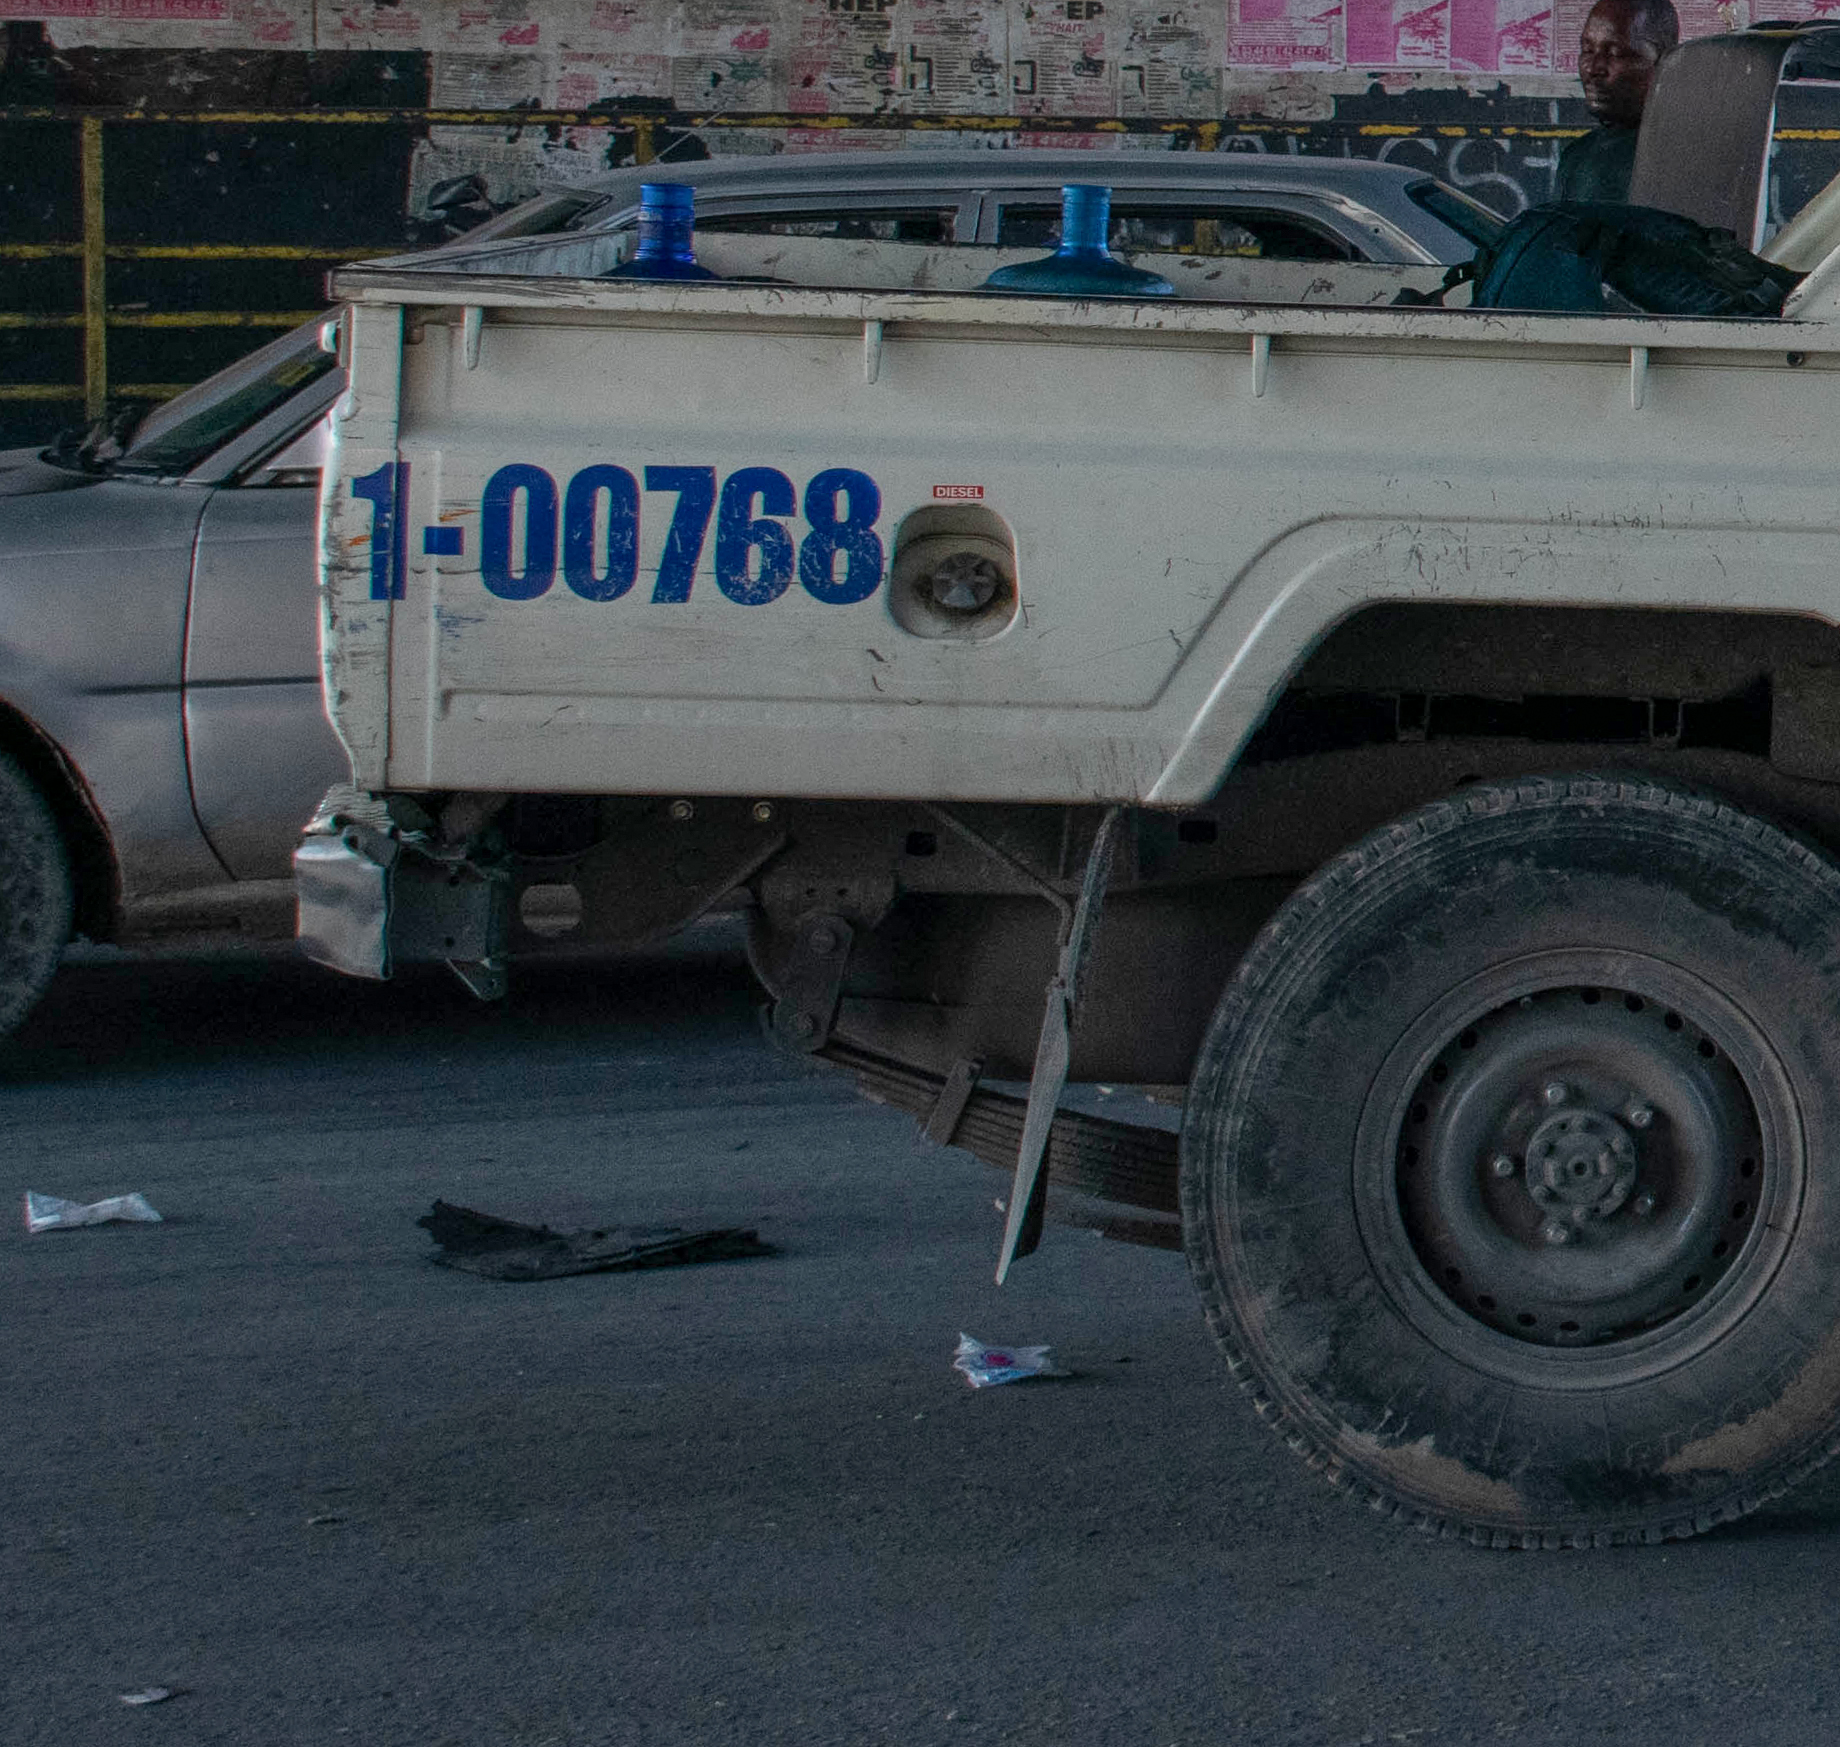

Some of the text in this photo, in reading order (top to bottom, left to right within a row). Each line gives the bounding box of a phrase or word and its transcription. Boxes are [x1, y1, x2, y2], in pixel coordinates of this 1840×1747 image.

[1067, 1, 1104, 20] EP
[935, 485, 983, 499] DIESEL
[352, 462, 883, 605] 1-00768
